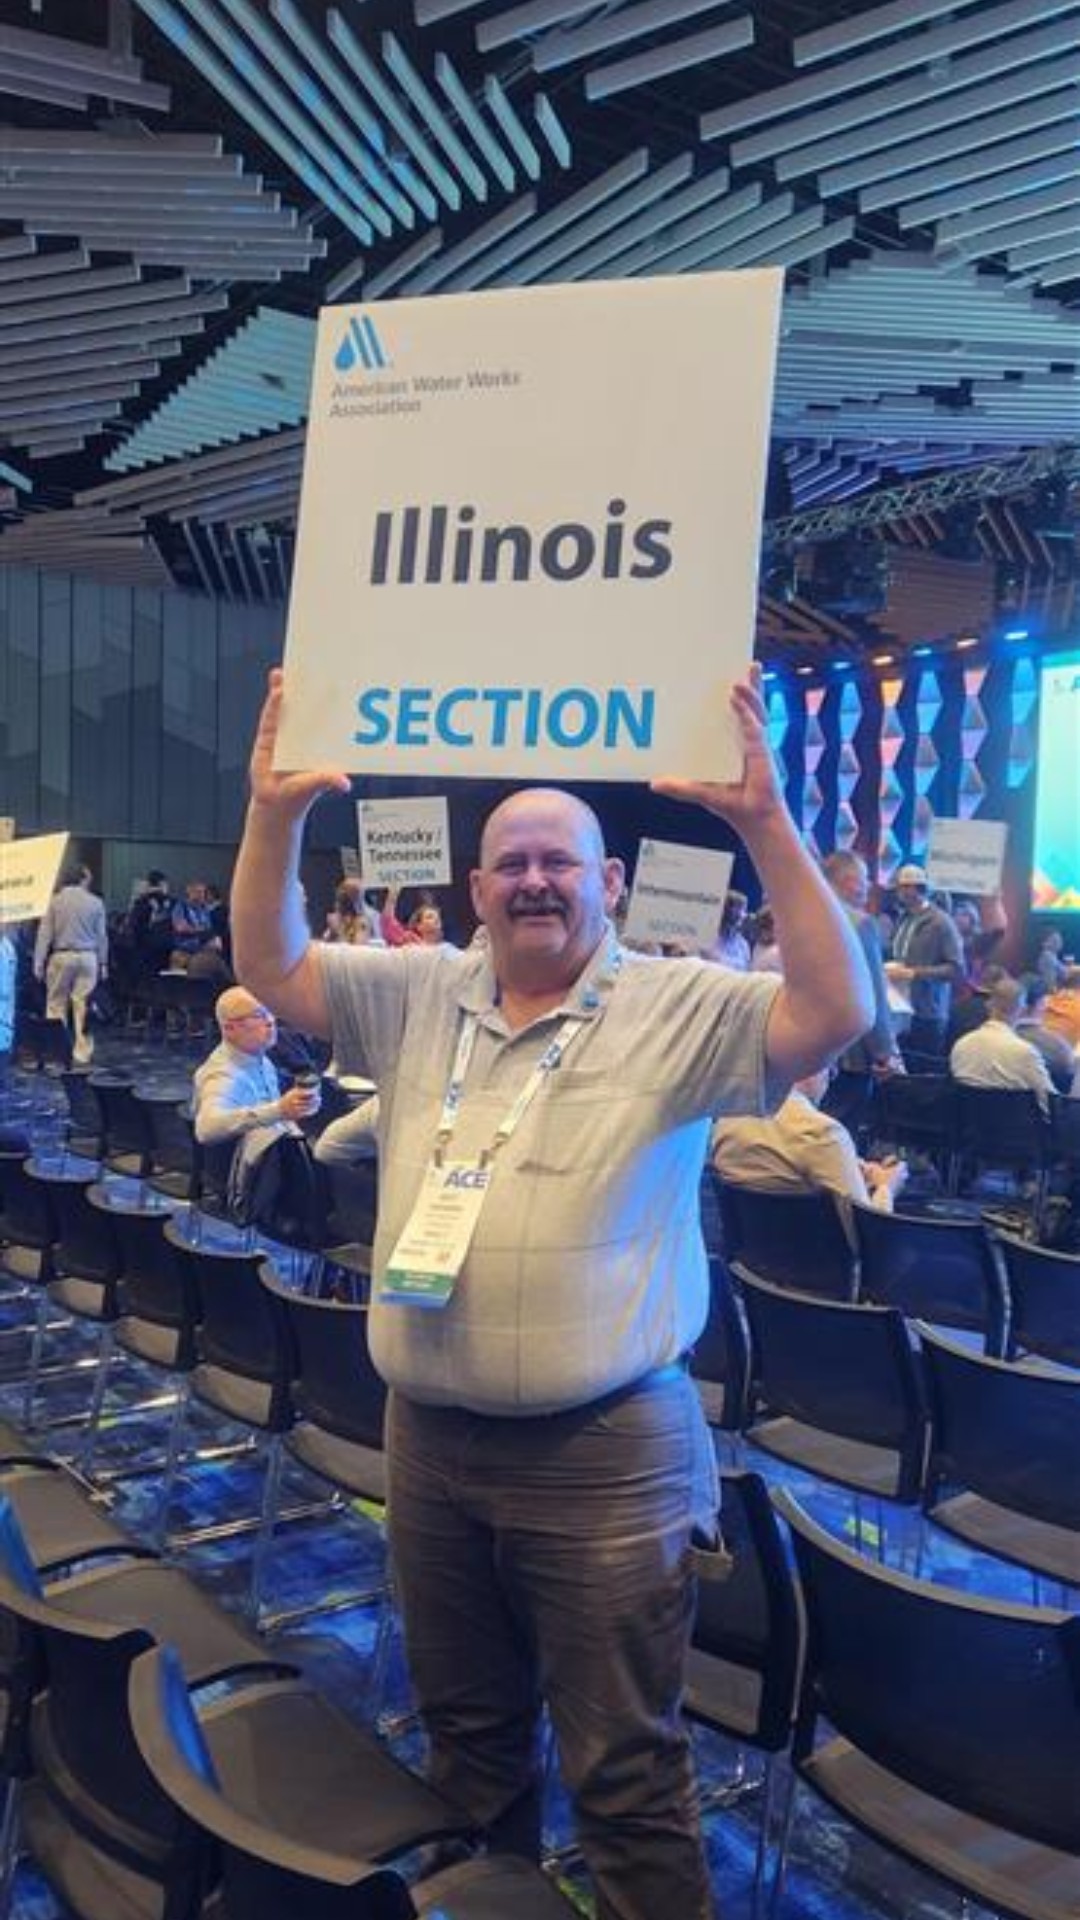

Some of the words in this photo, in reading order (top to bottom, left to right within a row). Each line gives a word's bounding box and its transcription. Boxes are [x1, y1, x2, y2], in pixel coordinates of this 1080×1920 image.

[331, 381, 407, 399] American
[411, 376, 462, 392] Water
[466, 370, 521, 388] Works
[329, 399, 421, 418] Association
[370, 499, 673, 586] Illinois
[353, 687, 655, 750] SECTION
[366, 828, 433, 846] Kentucky
[368, 849, 442, 864] Tennessee
[377, 868, 436, 883] SECTION
[443, 1170, 489, 1189] ACE
